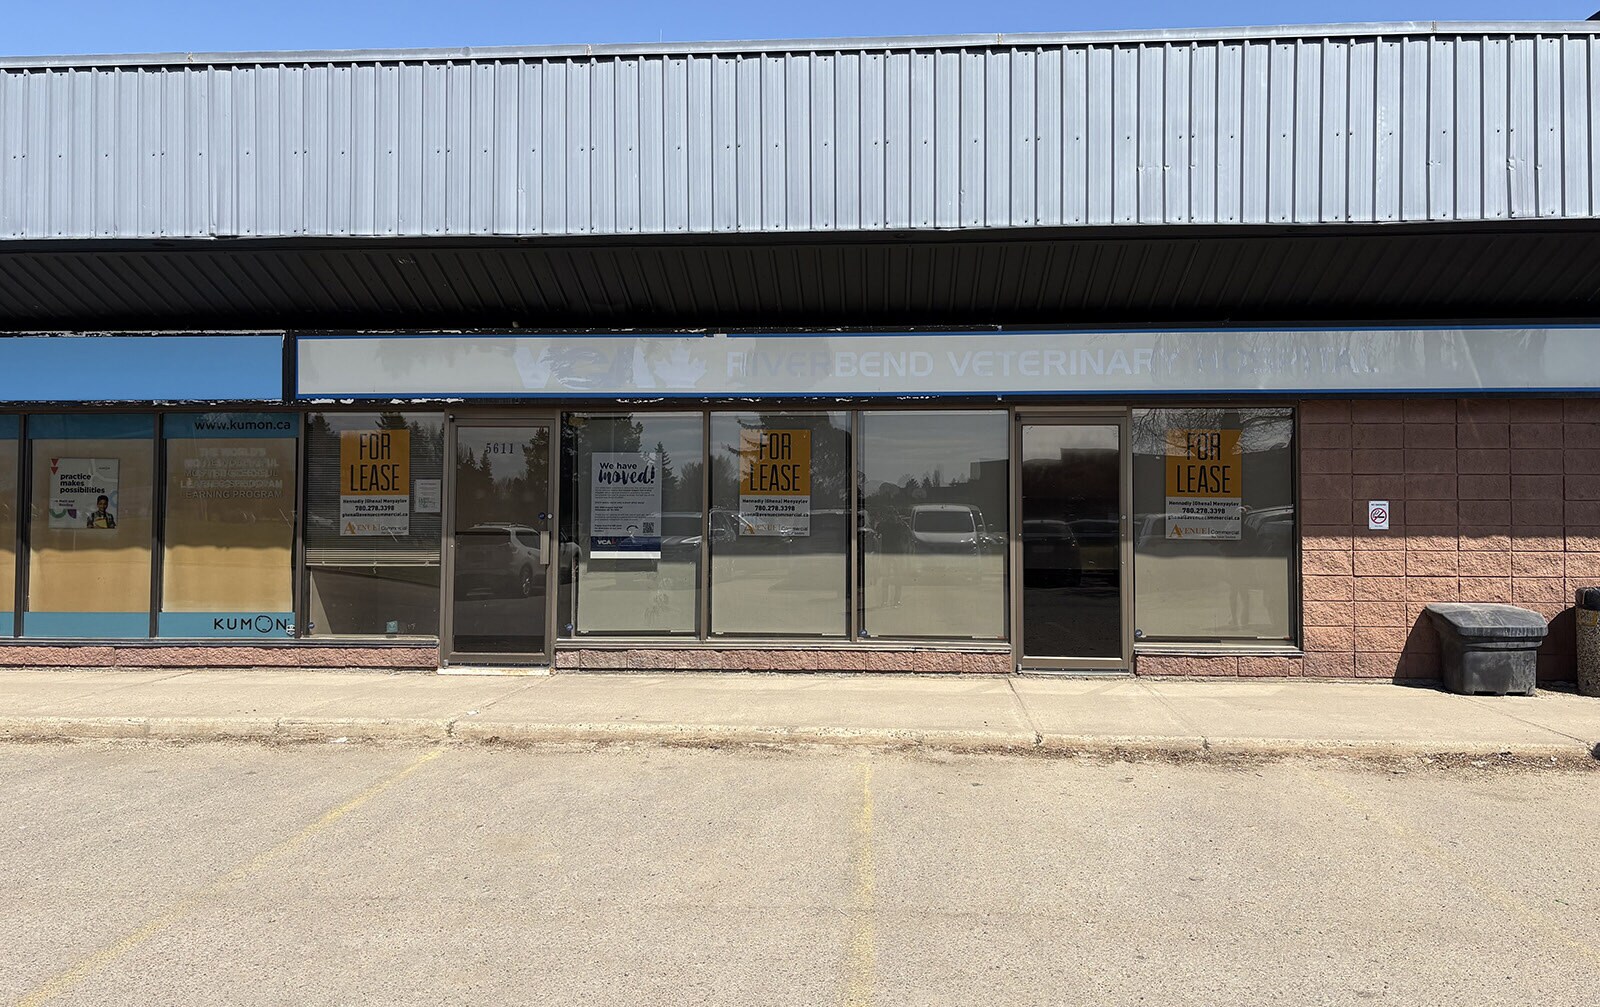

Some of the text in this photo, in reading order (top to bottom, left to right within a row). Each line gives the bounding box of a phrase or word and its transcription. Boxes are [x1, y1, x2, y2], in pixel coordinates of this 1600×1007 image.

[726, 351, 935, 377] RIVERBEND
[946, 348, 1183, 377] VETERINARY
[195, 419, 291, 431] www.kumon.ca
[360, 433, 391, 460] FOR
[486, 442, 514, 454] 5611
[760, 433, 791, 460] FOR
[1187, 432, 1221, 460] FOR
[60, 473, 92, 481] practice
[350, 464, 400, 491] LEASE
[598, 465, 656, 485] moved!
[750, 464, 801, 491] LEASE
[1177, 465, 1231, 493] LEASE
[60, 486, 106, 495] possibilities
[214, 615, 288, 634] KUMON
